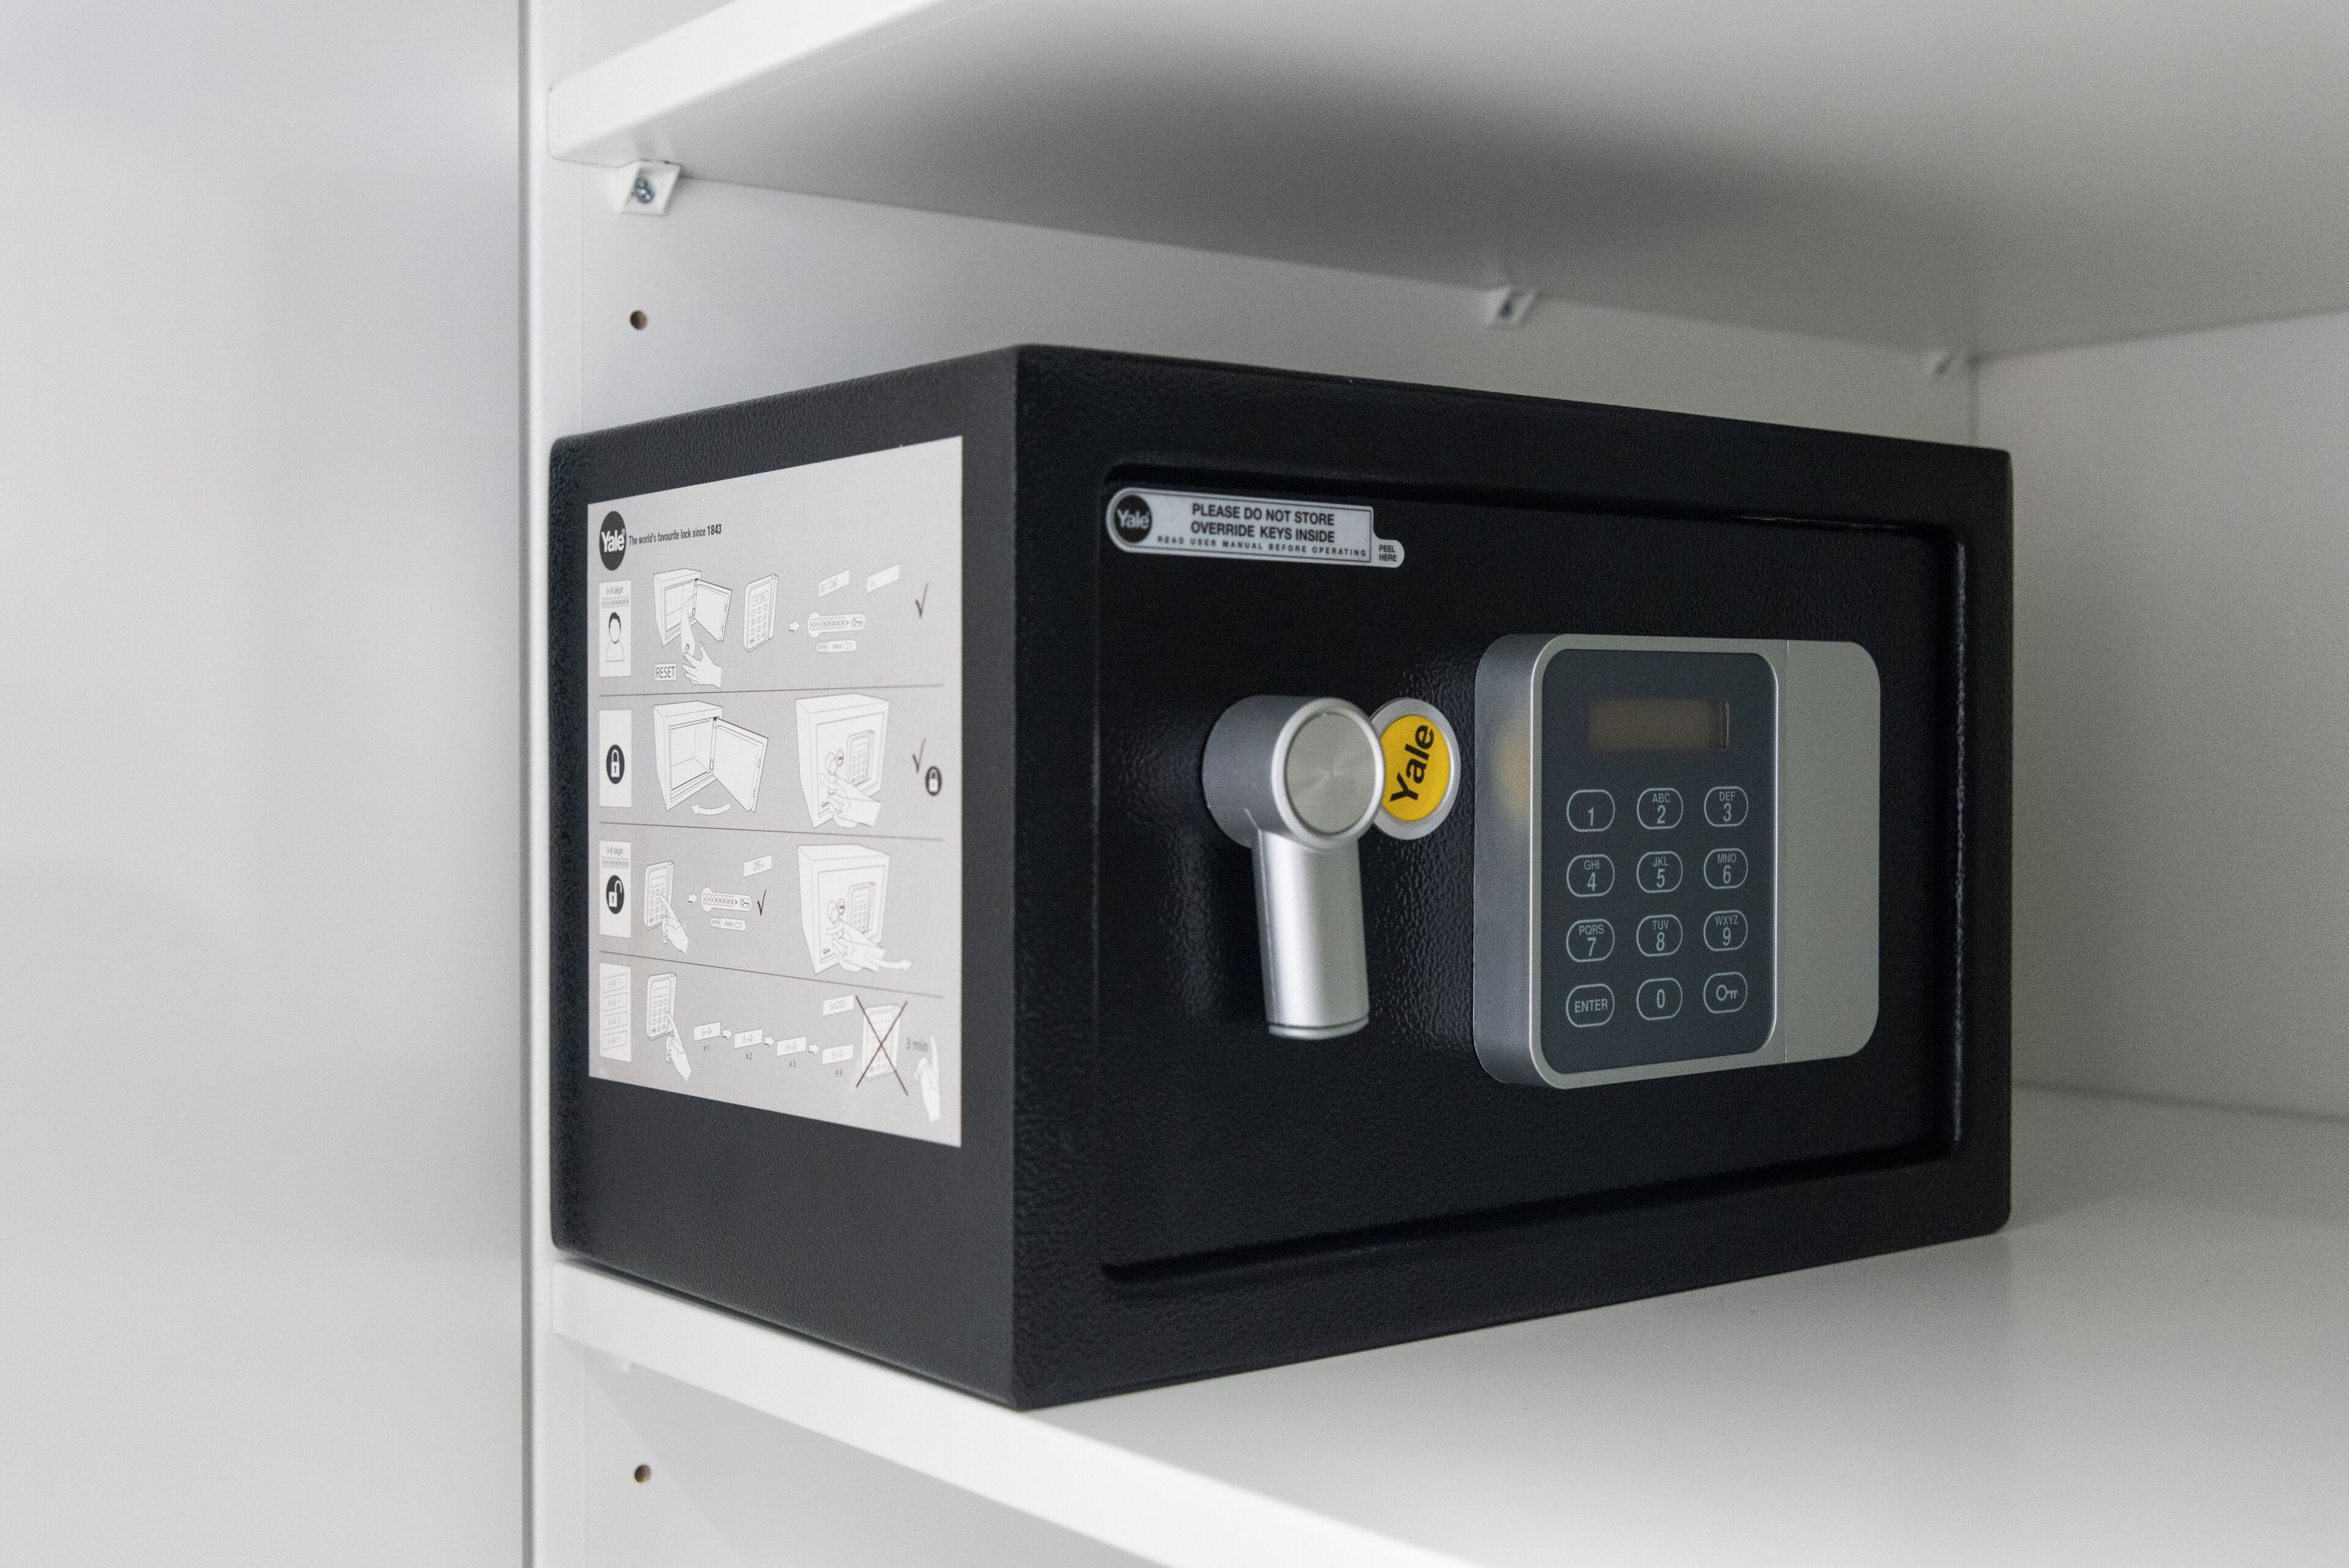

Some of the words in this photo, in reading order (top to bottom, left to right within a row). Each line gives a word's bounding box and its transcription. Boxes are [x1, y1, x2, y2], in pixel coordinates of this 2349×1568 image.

[1116, 508, 1149, 530] Yale
[1192, 503, 1241, 519] PLEASE
[1244, 507, 1262, 521] DO
[1266, 508, 1291, 522] NOT
[1294, 511, 1335, 526] STORE
[601, 530, 625, 552] Yale
[629, 535, 637, 545] The
[639, 532, 656, 544] world's
[657, 530, 680, 541] favourite
[680, 527, 691, 539] lock
[692, 527, 706, 538] since
[707, 524, 722, 535] 1843
[1191, 521, 1255, 537] OVERRIDE
[1260, 526, 1292, 540] KEYS
[1296, 529, 1335, 543] INSIDE
[1157, 535, 1184, 544] READ
[1190, 538, 1216, 547] USER
[1223, 540, 1263, 550] MANUAL
[1269, 543, 1306, 553] BEFORE
[1312, 546, 1366, 557] OPERATING
[1379, 544, 1395, 553] PEEL
[656, 666, 675, 678] RESET
[1389, 725, 1434, 802] Yale
[1652, 793, 1671, 803] ABC
[1719, 792, 1735, 801] DEF
[1587, 807, 1594, 827] 1
[1657, 805, 1666, 824] 2
[1723, 803, 1732, 822] 3
[1584, 860, 1600, 871] GHI
[1652, 857, 1669, 867] JKL
[1717, 853, 1737, 863] MNO
[1587, 872, 1597, 891] 4
[1656, 869, 1665, 888] 5
[1723, 865, 1731, 884] 6
[1579, 924, 1605, 936] PQRS
[1652, 920, 1669, 930] TUV
[1715, 915, 1739, 926] WXYZ
[1656, 932, 1665, 951] 8
[1723, 927, 1731, 946] 9
[1587, 937, 1597, 956] 7
[1574, 998, 1608, 1013] ENTER
